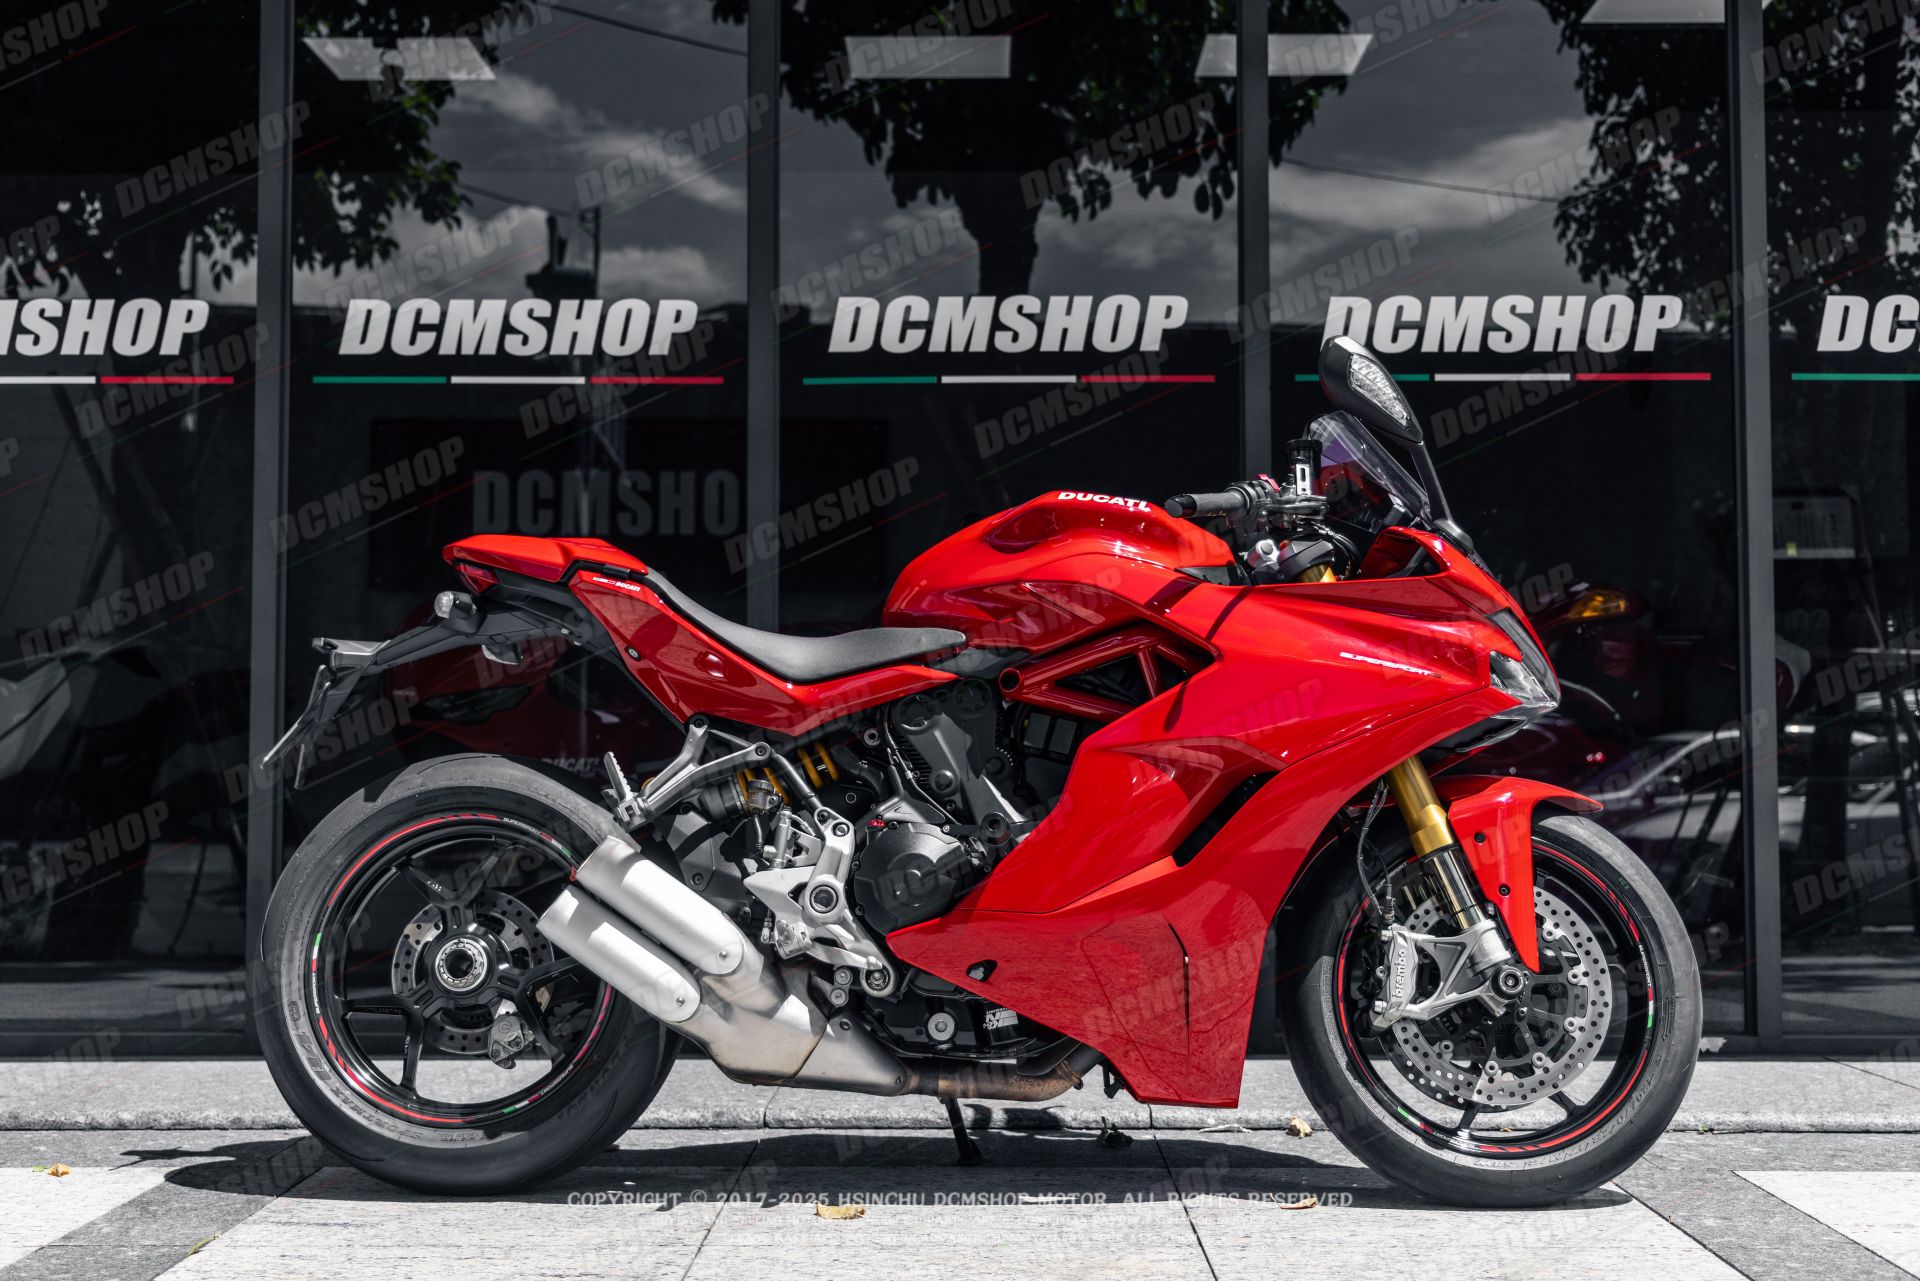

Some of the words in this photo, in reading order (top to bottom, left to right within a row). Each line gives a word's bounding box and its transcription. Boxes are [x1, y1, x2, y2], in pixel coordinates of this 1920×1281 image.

[338, 298, 699, 356] DCMSHOP
[828, 295, 1190, 354] DCMSHOP
[1320, 295, 1684, 354] DCMSHOP
[1816, 294, 1920, 353] DC
[472, 469, 740, 537] DCMSHO
[1058, 491, 1151, 512] DUCATI
[1392, 948, 1408, 1000] brembo
